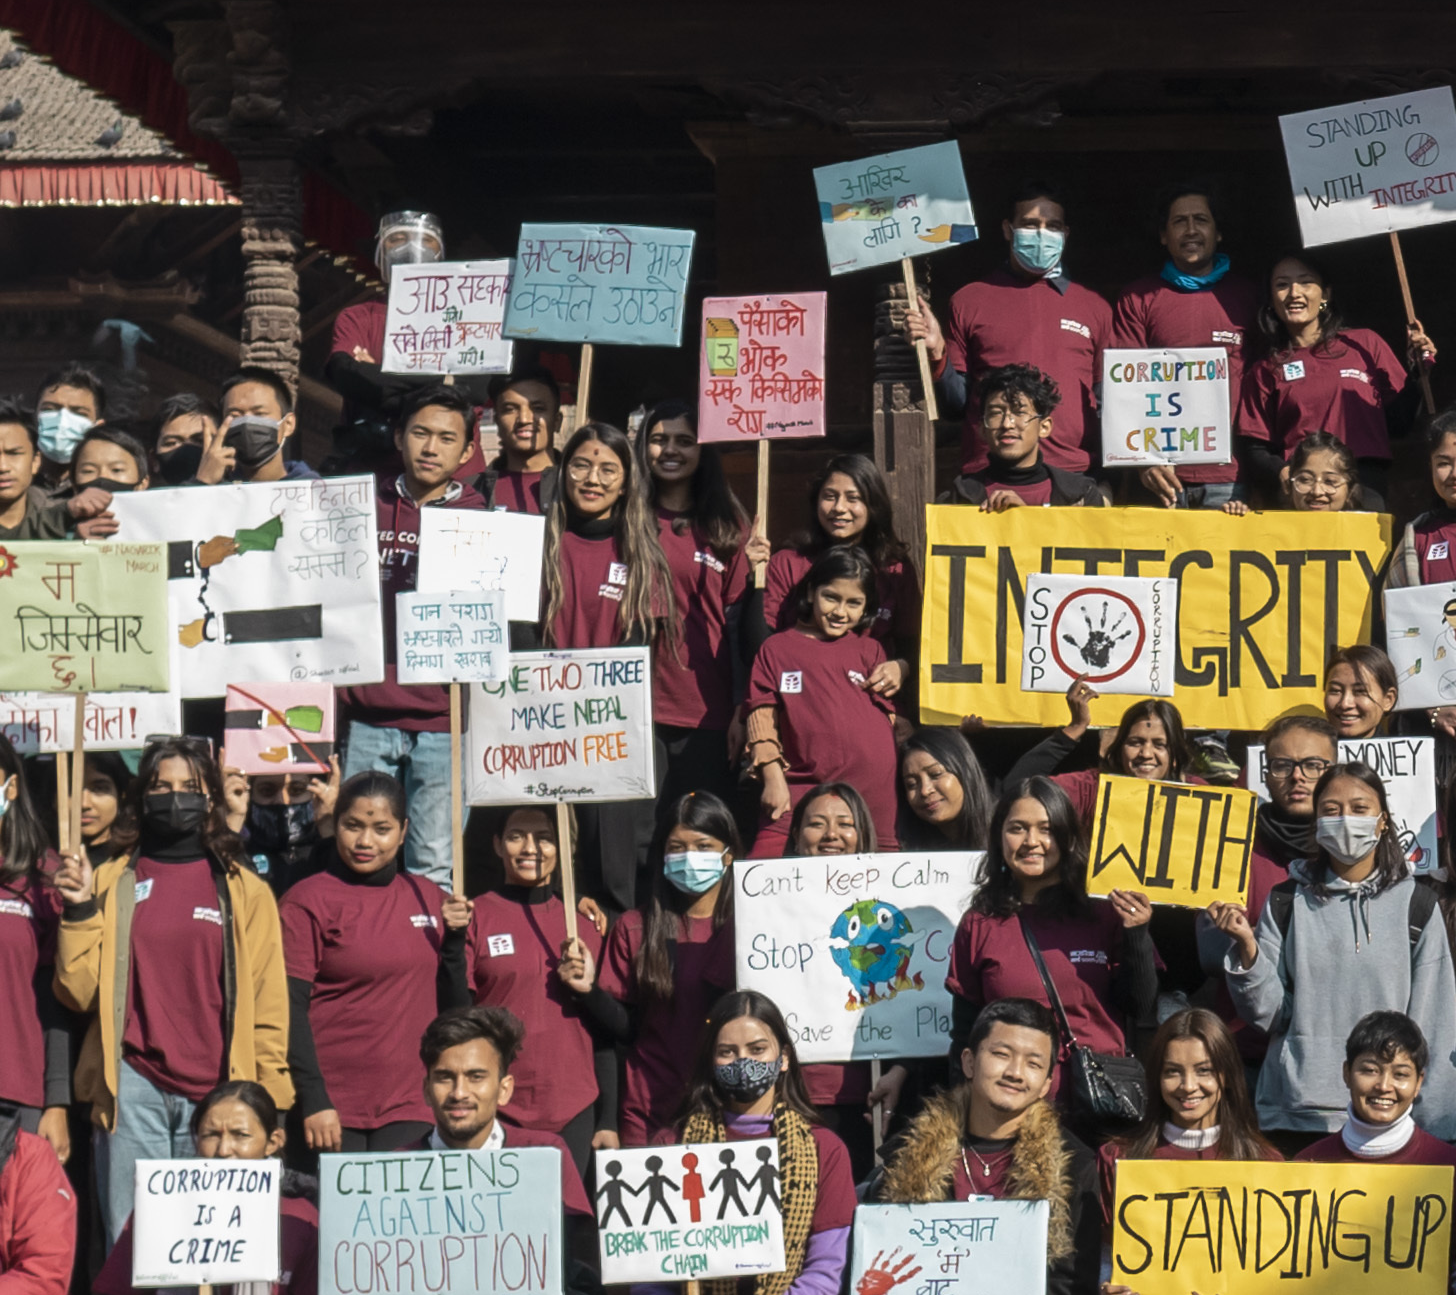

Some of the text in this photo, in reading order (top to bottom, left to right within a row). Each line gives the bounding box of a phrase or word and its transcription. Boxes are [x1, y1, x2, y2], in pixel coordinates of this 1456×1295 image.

[1306, 104, 1421, 148] STANDING
[1354, 141, 1386, 167] UP
[1303, 172, 1365, 211] WITH
[911, 216, 922, 234] ?
[1109, 357, 1227, 383] CORRUPTION
[1145, 392, 1183, 417] IS
[1126, 426, 1217, 453] CRIME
[41, 562, 82, 603] म
[14, 602, 153, 654] जिम्मेवार
[931, 545, 1393, 696] INGRITY
[1030, 586, 1051, 689] STOP
[1150, 580, 1163, 692] CORRUPTION
[586, 660, 644, 686] THREE
[511, 695, 627, 731] MAKE NEPAL
[483, 731, 628, 778] CORRUPTION FREE
[1344, 740, 1423, 777] MONEY
[1092, 780, 1255, 892] WITH
[741, 859, 950, 898] Can't keep Calm
[748, 934, 814, 972] Stop
[783, 1014, 833, 1046] Save
[857, 1014, 893, 1042] the
[147, 1168, 271, 1195] CORRUPTION
[336, 1152, 519, 1195] CITIZENS
[193, 1204, 241, 1227] IS A
[353, 1192, 512, 1237] AGAINST
[1116, 1186, 1447, 1281] STANDING UP
[168, 1238, 246, 1265] CRIME
[605, 1220, 769, 1258] BREAK THE CORRUPTION
[334, 1232, 547, 1294] CORRUPTION
[661, 1253, 709, 1275] CHAIN
